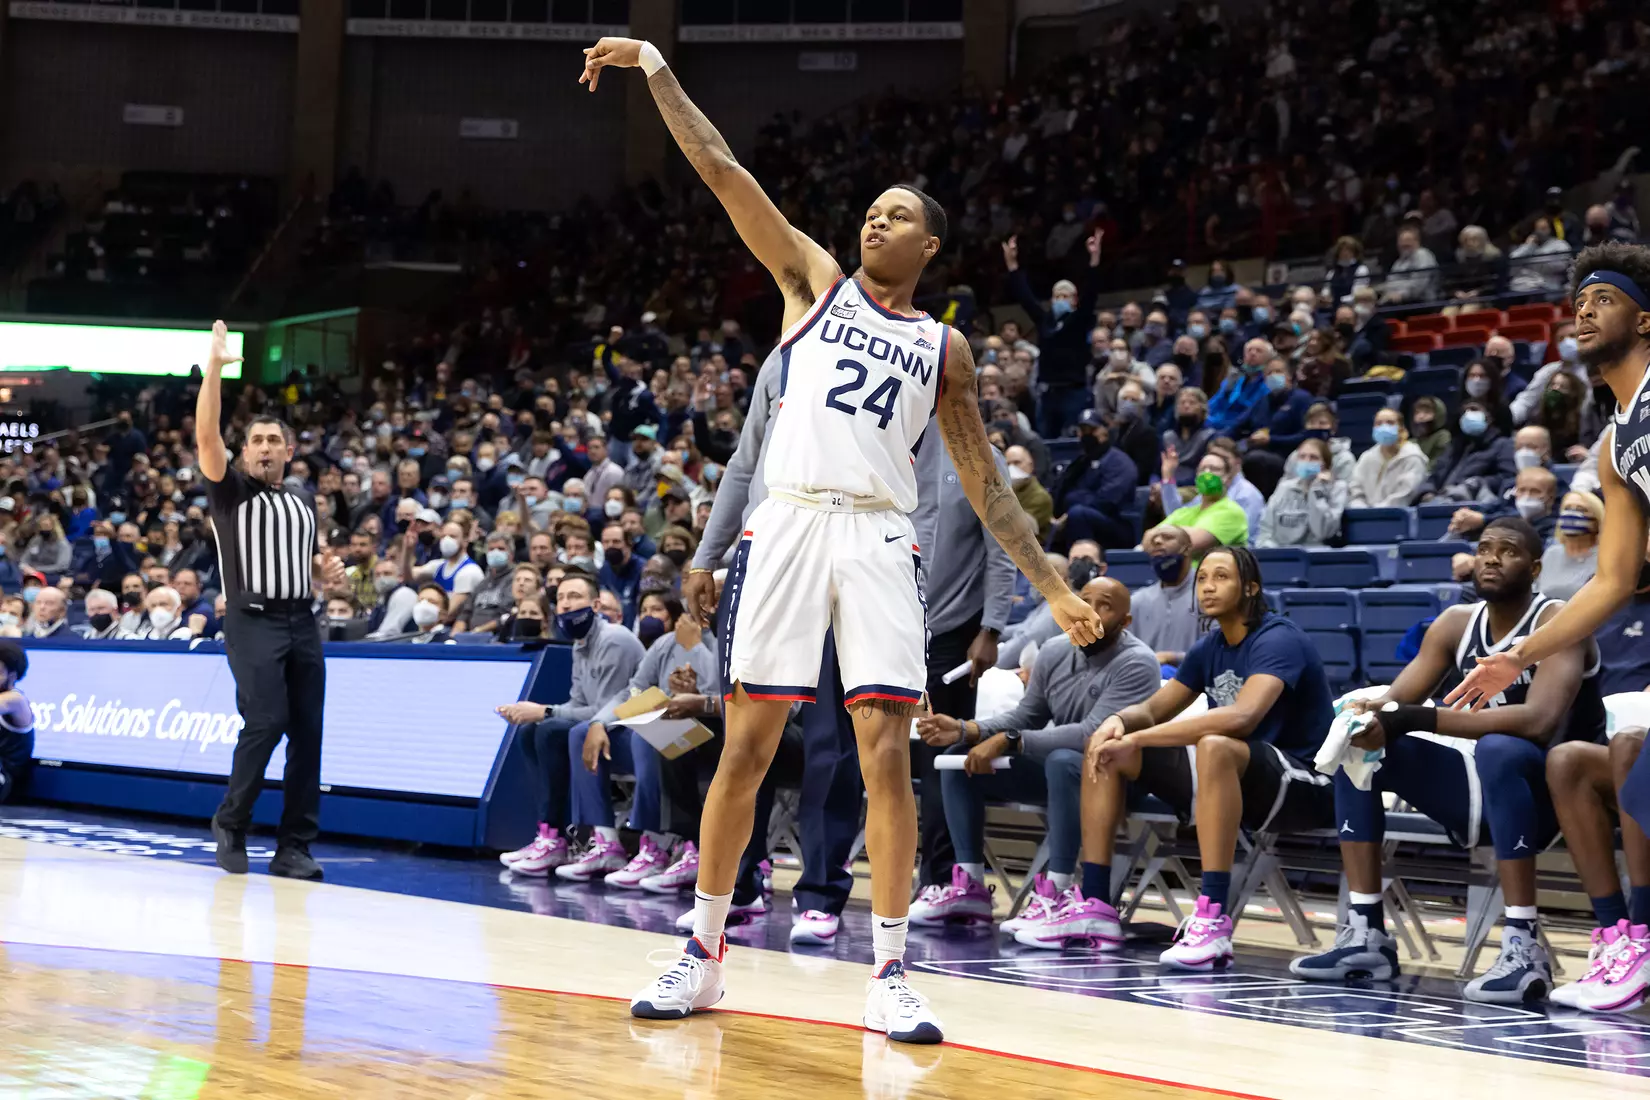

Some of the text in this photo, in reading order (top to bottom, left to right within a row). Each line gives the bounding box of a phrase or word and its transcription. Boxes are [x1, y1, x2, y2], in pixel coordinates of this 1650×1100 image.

[820, 320, 933, 386] UCONN
[825, 358, 903, 430] 24
[52, 693, 154, 738] Solutions
[156, 698, 246, 753] Compa
